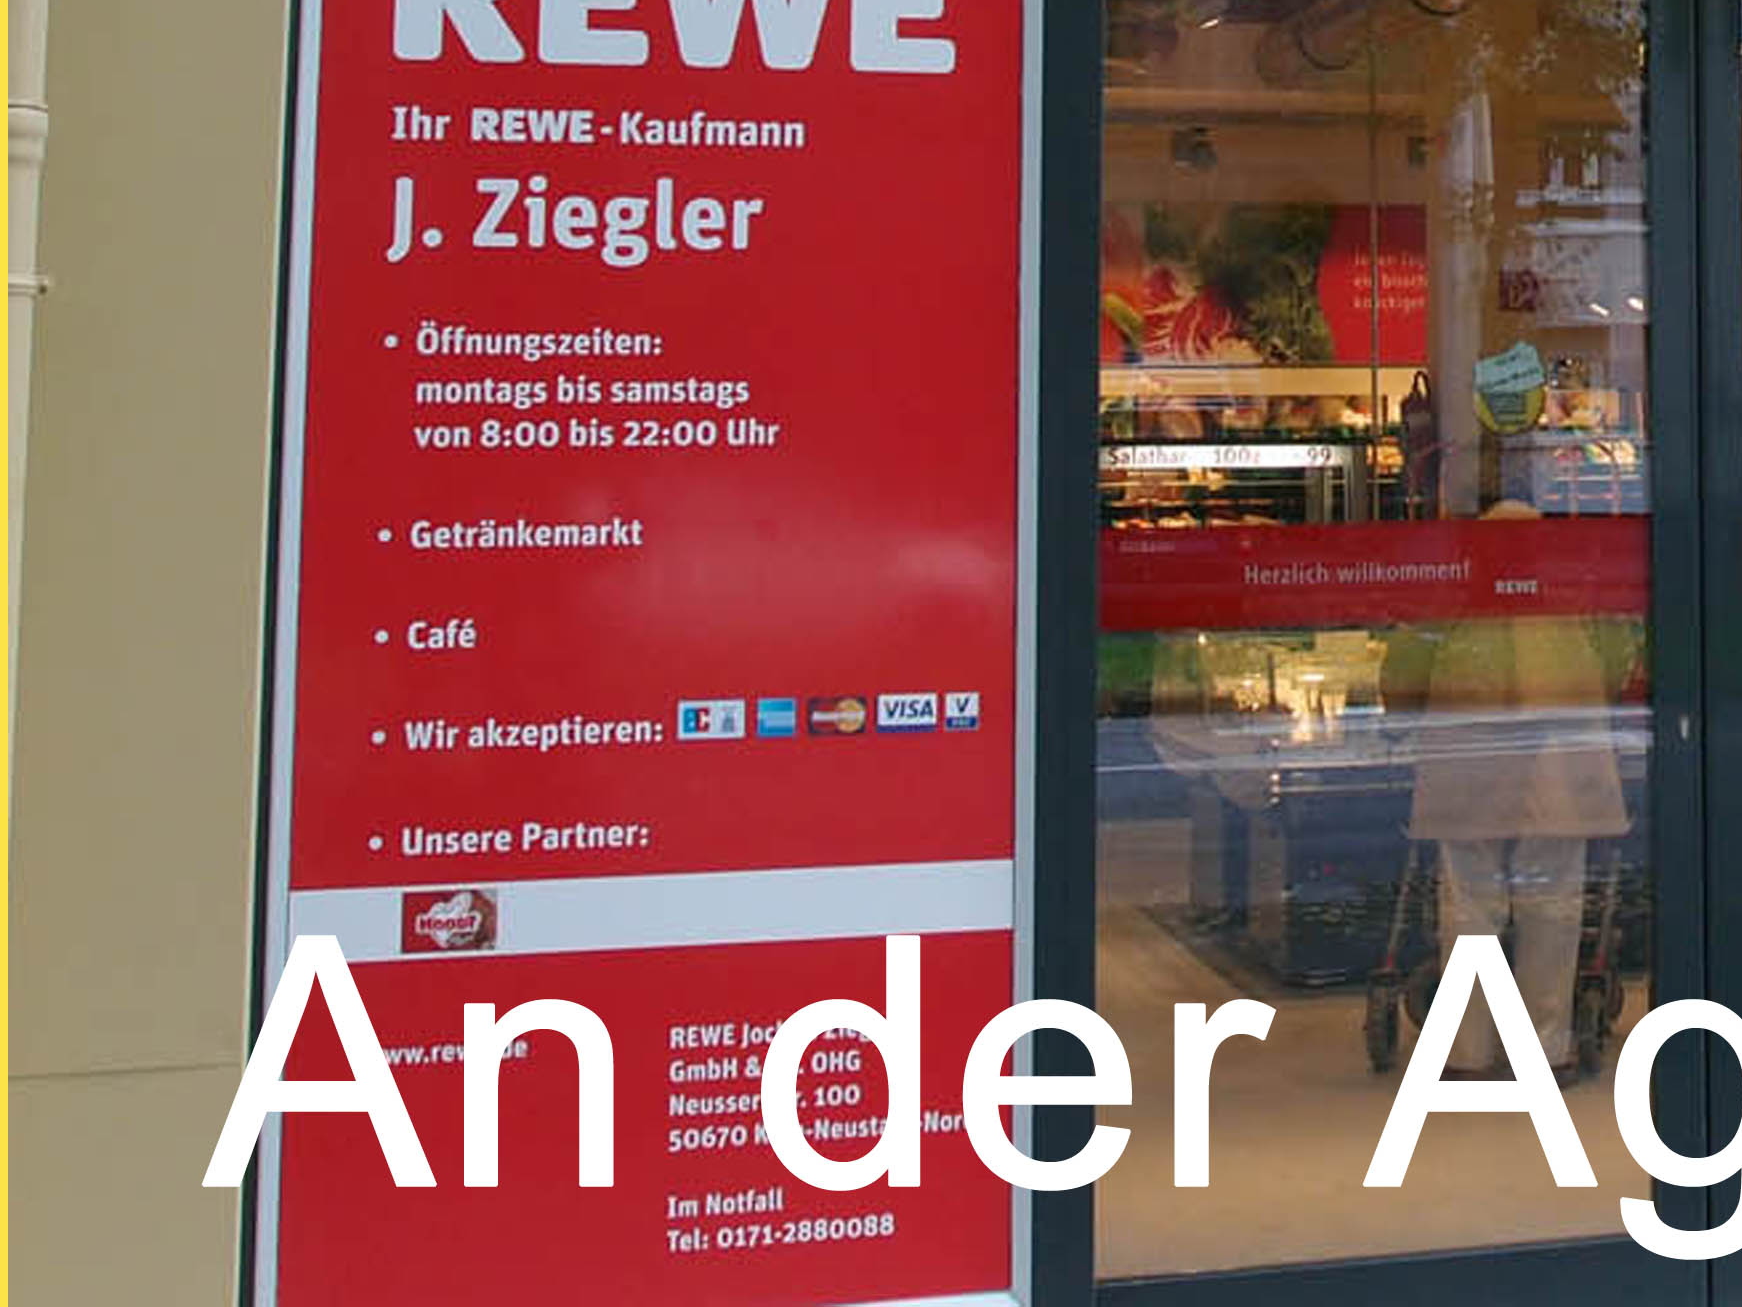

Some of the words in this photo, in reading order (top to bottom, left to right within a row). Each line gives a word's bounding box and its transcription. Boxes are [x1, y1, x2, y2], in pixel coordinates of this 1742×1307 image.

[391, 106, 452, 141] Ihr
[386, 176, 443, 262] J.
[472, 175, 764, 267] Ziegler
[416, 321, 663, 361] Öffnungszeiten:
[415, 378, 548, 409] montags
[556, 375, 601, 404] bis
[609, 378, 750, 409] samstags
[414, 424, 472, 449] von
[480, 420, 560, 448] 8:00
[568, 418, 614, 447] bis
[622, 420, 717, 448] 22:00
[726, 417, 780, 447] Uhr
[410, 518, 643, 548] Getränkemarkt
[1243, 563, 1329, 585] Herzlich
[407, 619, 477, 649] Café
[885, 699, 935, 722] VISA
[404, 719, 460, 750] Wir
[467, 716, 664, 752] akzeptieren:
[402, 827, 512, 856] Unsere
[522, 822, 650, 851] Partner:
[670, 1022, 735, 1049] REWE
[669, 1056, 738, 1082] GmbH
[744, 1054, 762, 1078] &
[811, 1051, 862, 1074] OHG
[668, 1092, 761, 1116] Neusser
[813, 1084, 862, 1107] 100
[667, 1125, 748, 1153] 50670
[667, 1195, 699, 1219] Im
[705, 1188, 784, 1216] Notfall
[667, 1228, 708, 1253] Tel:
[716, 1212, 895, 1249] 0171-2880088
